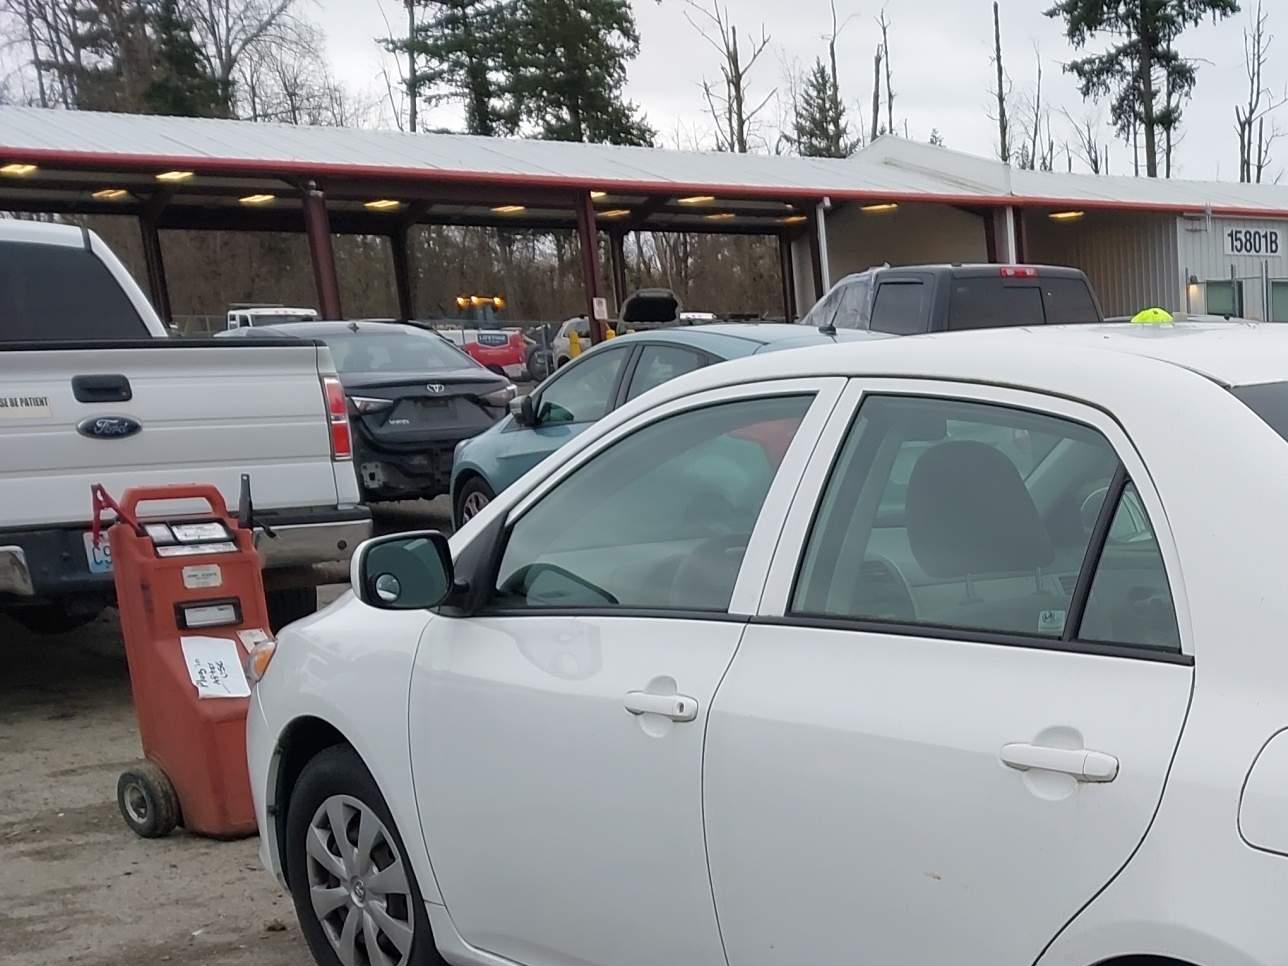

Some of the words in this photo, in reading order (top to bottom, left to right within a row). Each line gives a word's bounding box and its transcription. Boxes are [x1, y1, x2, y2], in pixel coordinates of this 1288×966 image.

[1227, 229, 1279, 254] 15801B
[20, 396, 48, 407] PATIENT
[93, 418, 129, 435] Ford
